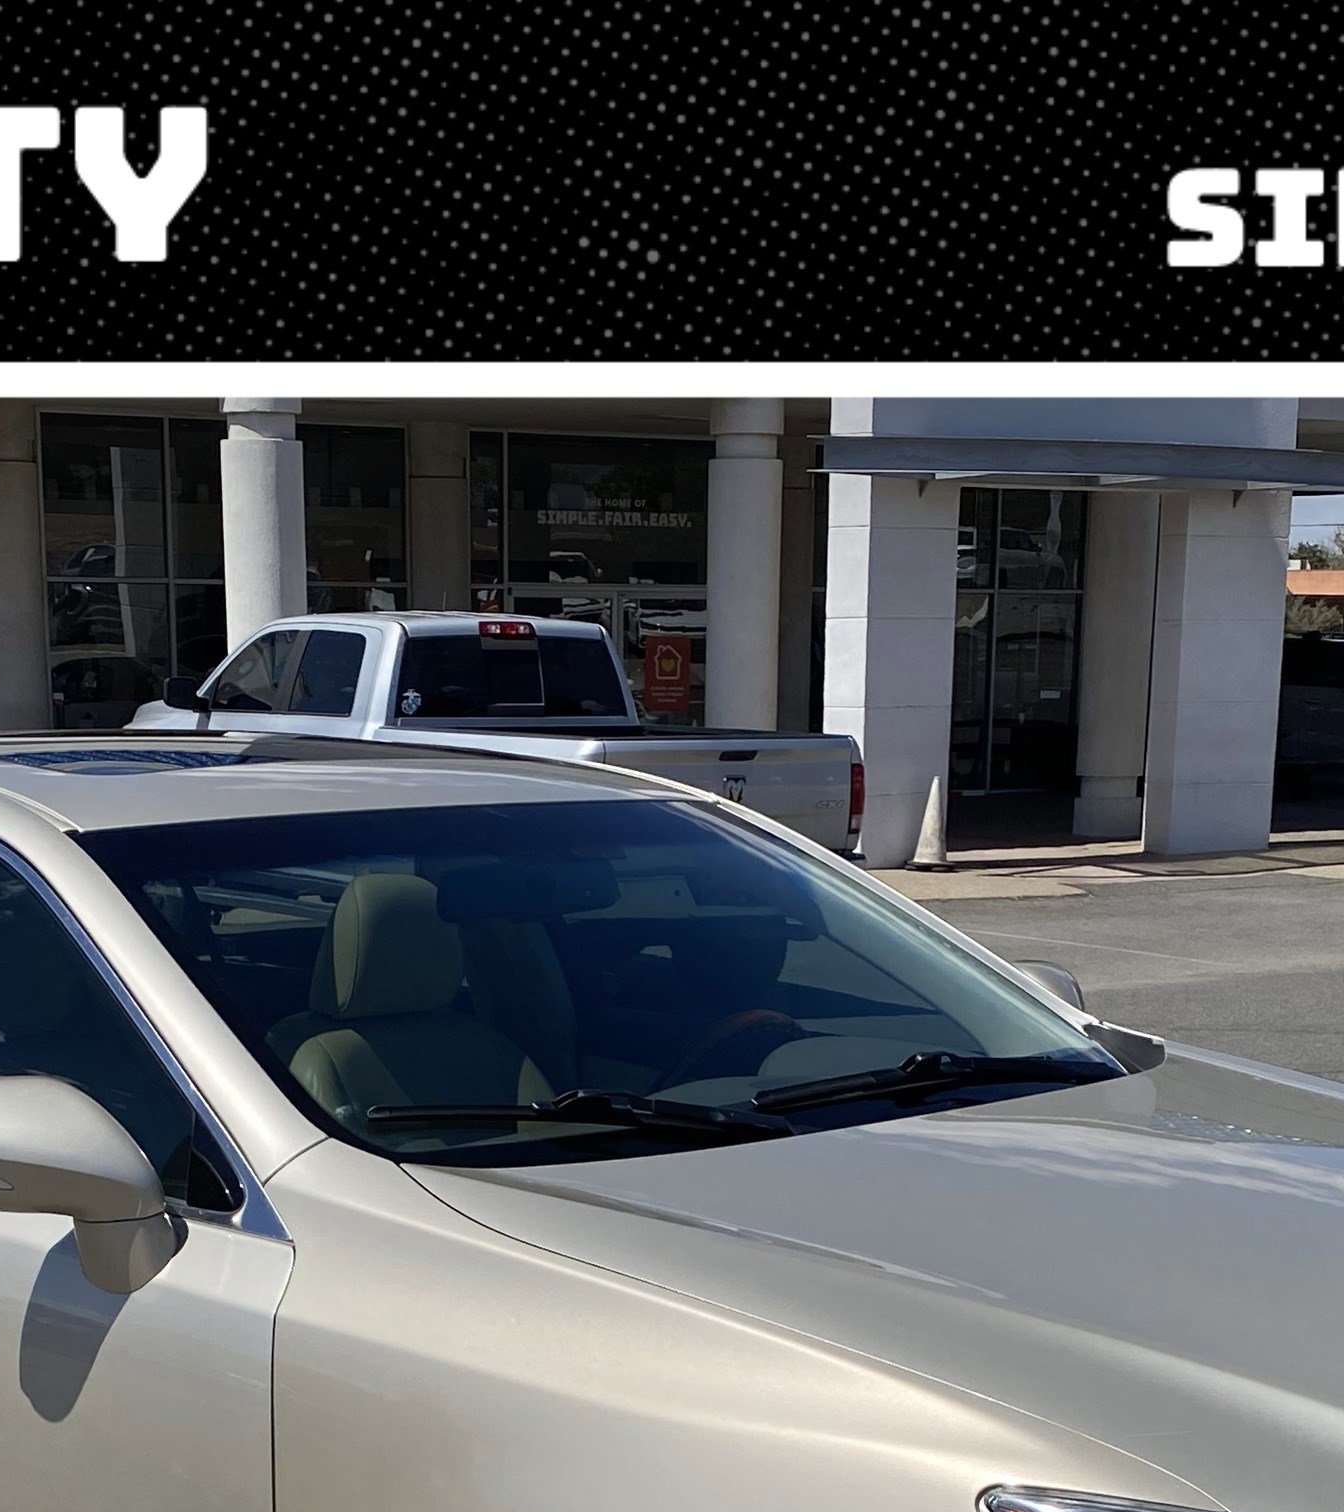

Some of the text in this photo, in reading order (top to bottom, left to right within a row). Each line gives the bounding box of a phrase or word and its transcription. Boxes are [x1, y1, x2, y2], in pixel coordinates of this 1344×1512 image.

[604, 497, 632, 508] HOME
[634, 498, 647, 508] OF
[537, 510, 692, 527] SIMPLE.FAIR.EASY.
